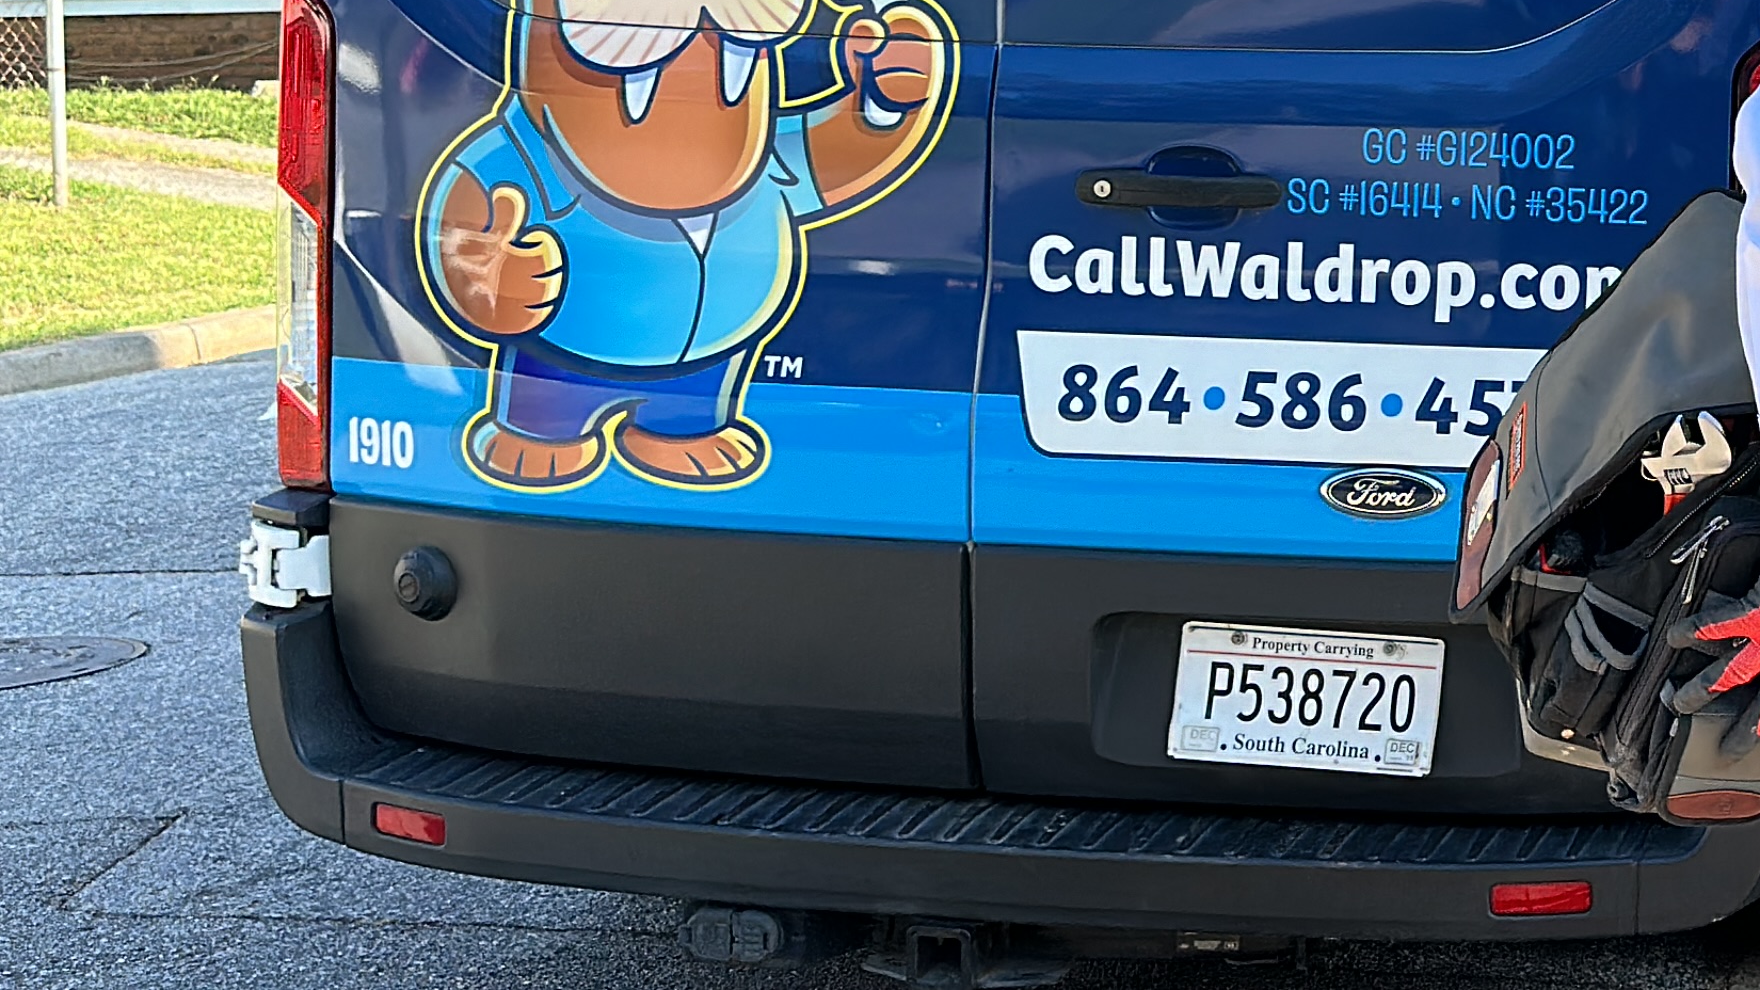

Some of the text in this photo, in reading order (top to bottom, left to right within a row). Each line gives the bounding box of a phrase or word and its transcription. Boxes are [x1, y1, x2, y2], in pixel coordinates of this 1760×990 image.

[1362, 127, 1408, 166] GC
[1286, 177, 1649, 226] SC #16414 NC #35422
[763, 354, 804, 379] TM
[1414, 376, 1527, 437] 45
[348, 416, 415, 470] 1910
[1346, 477, 1417, 508] Ford
[1252, 636, 1375, 660] Property Carrying
[1204, 661, 1417, 734] P538720
[1232, 732, 1370, 760] South Carolina
[1389, 741, 1416, 754] DEC
